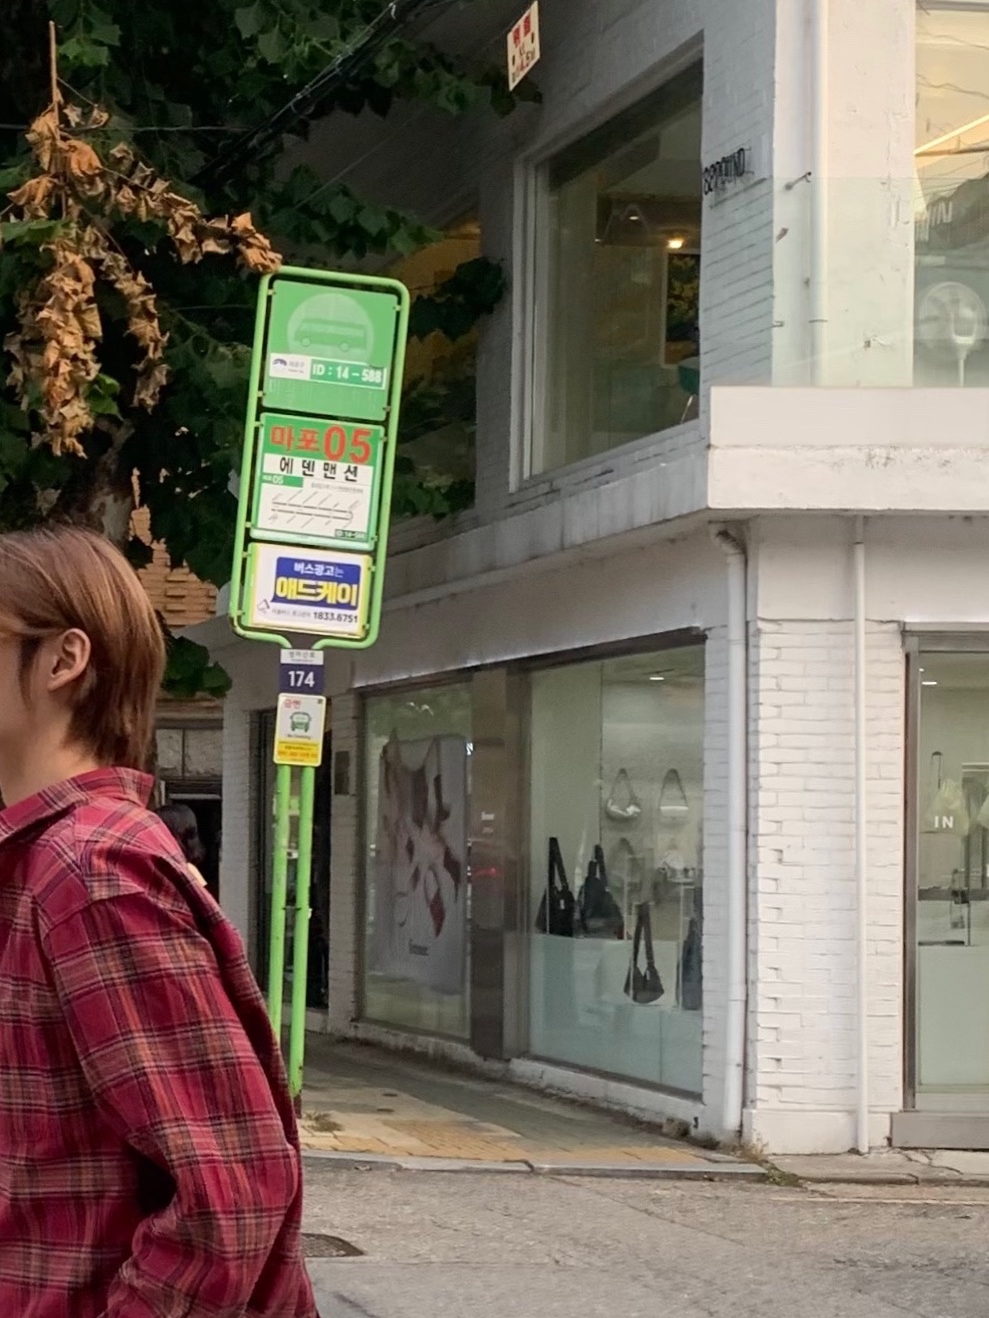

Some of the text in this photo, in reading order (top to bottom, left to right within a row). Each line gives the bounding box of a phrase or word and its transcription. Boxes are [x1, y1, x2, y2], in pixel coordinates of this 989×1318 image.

[312, 363, 325, 376] ID
[293, 561, 344, 578] 버스광고는
[275, 576, 358, 607] 애드케이
[288, 670, 315, 687] 174
[934, 815, 954, 829] IN
